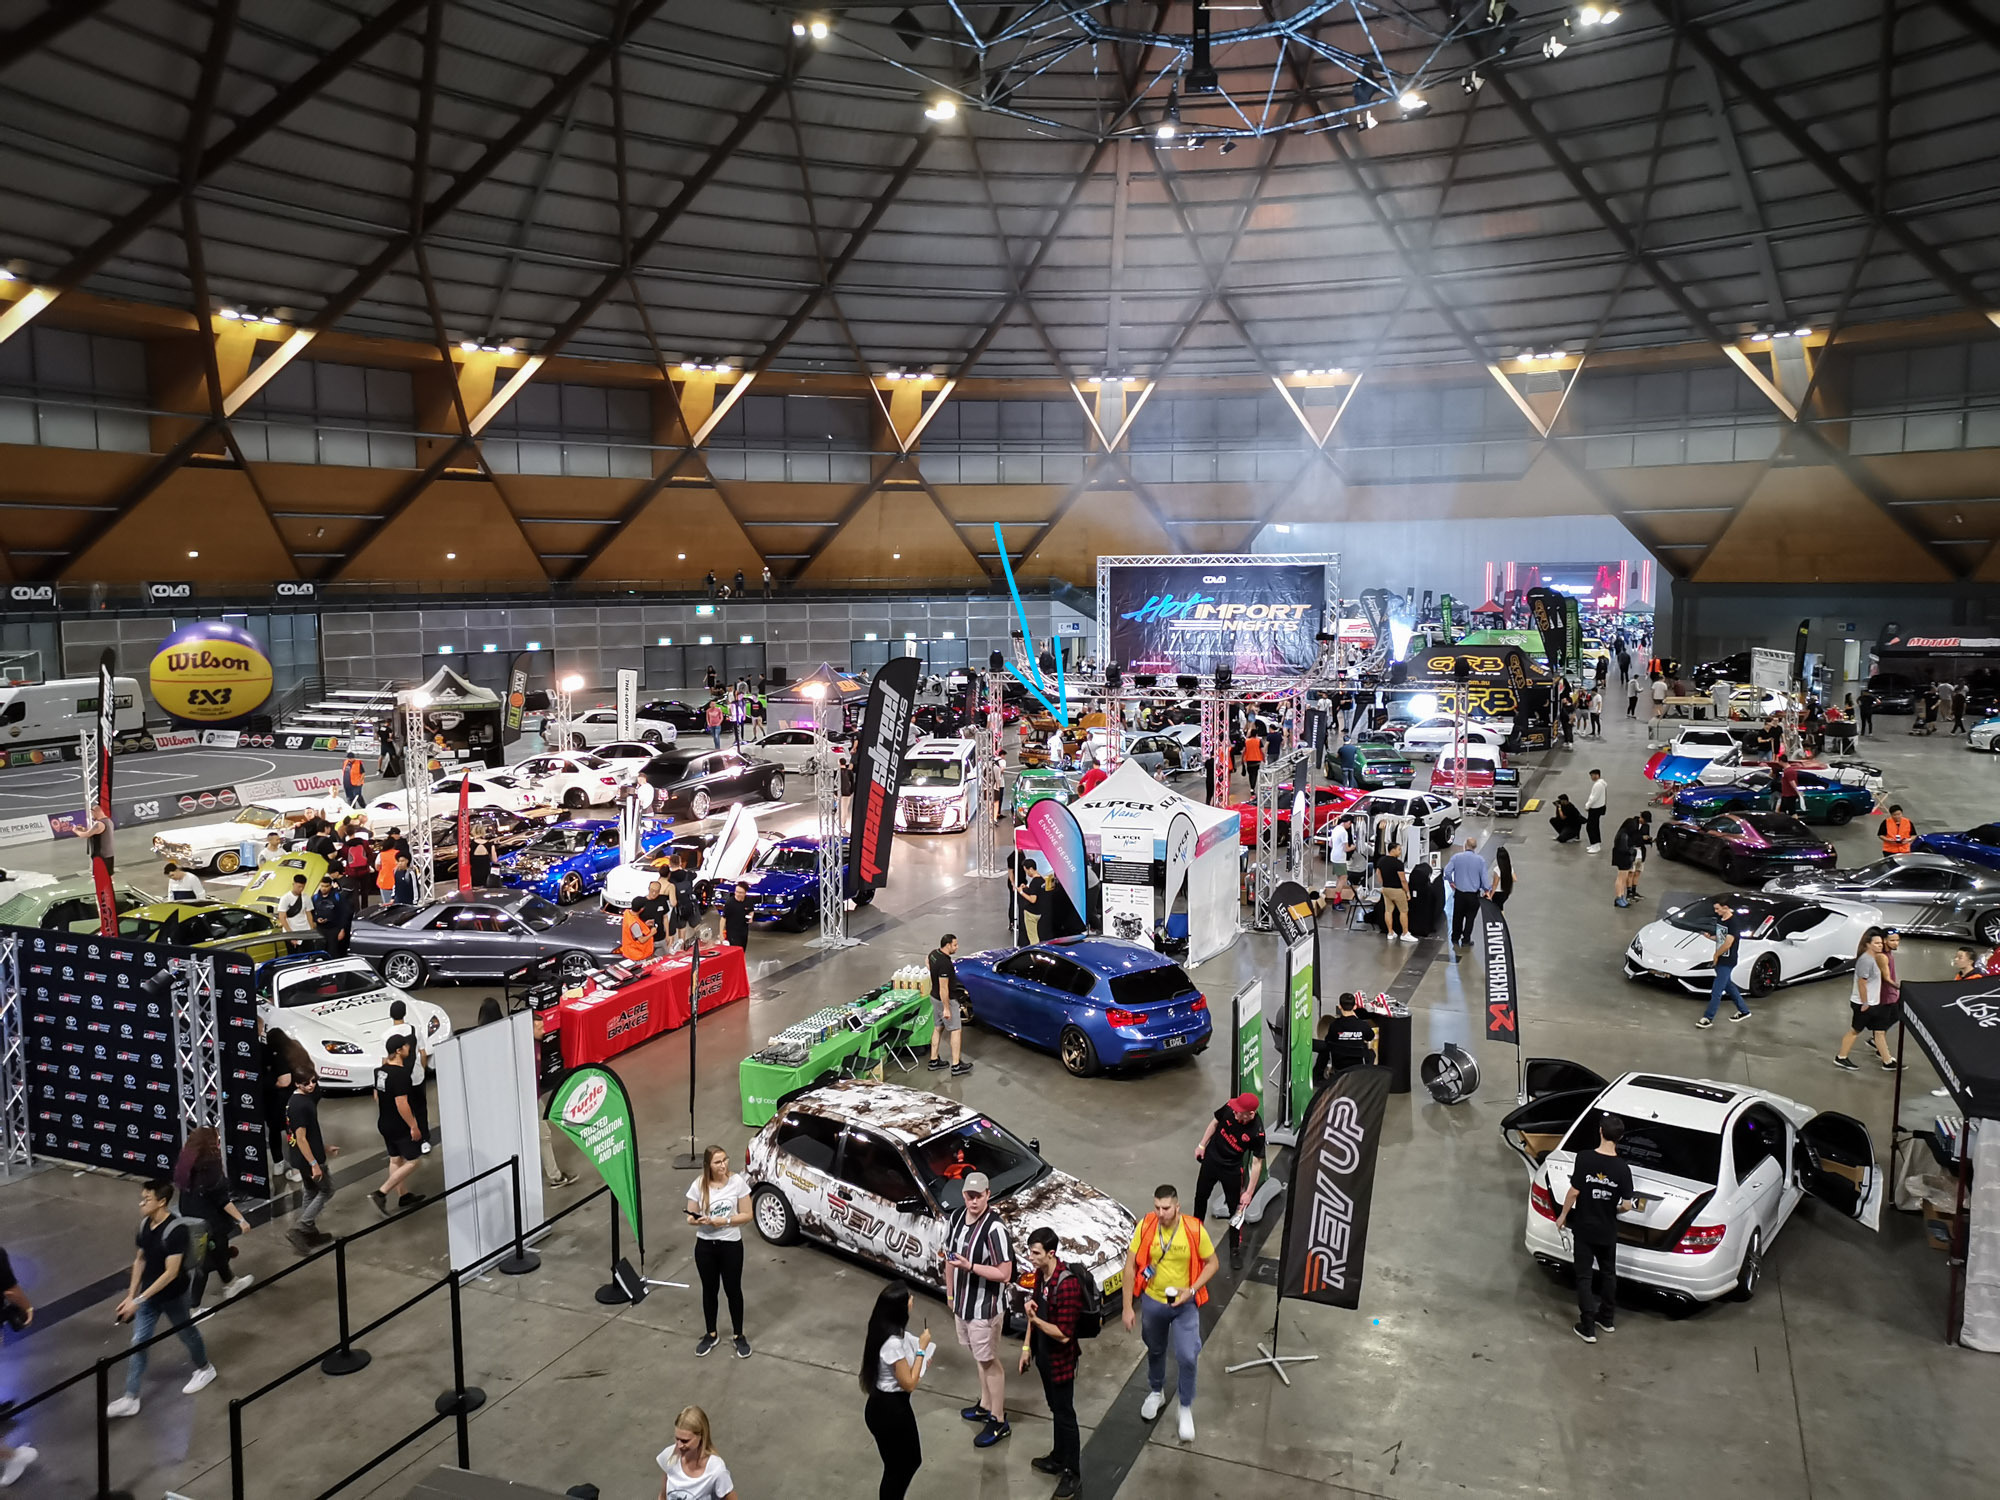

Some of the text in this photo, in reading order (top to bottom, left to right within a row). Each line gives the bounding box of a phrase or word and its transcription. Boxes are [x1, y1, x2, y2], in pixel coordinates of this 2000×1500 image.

[1121, 593, 1312, 623] Hot IMPORT
[1222, 620, 1299, 631] NIGHTS
[1906, 637, 1960, 647] MOTIVE
[167, 651, 249, 672] Wilson
[156, 736, 196, 747] Wilson
[886, 697, 909, 795] CUSTOMS
[293, 776, 341, 792] Wilson
[1082, 800, 1154, 812] SUPER
[1043, 814, 1065, 839] ACTIVE
[1038, 820, 1076, 873] ENGINE REPAIR
[1173, 830, 1190, 864] SUPER
[1277, 903, 1297, 939] LEADING
[317, 996, 395, 1017] BRAKES
[619, 1001, 649, 1021] ACRE
[607, 1013, 649, 1040] BRAKES
[322, 1068, 347, 1076] MOTUL
[570, 1085, 603, 1118] Turtle
[594, 1135, 615, 1156] INSIDE
[599, 1148, 612, 1164] AND
[1303, 1096, 1365, 1295] REV UP
[827, 1193, 923, 1258] REV UP
